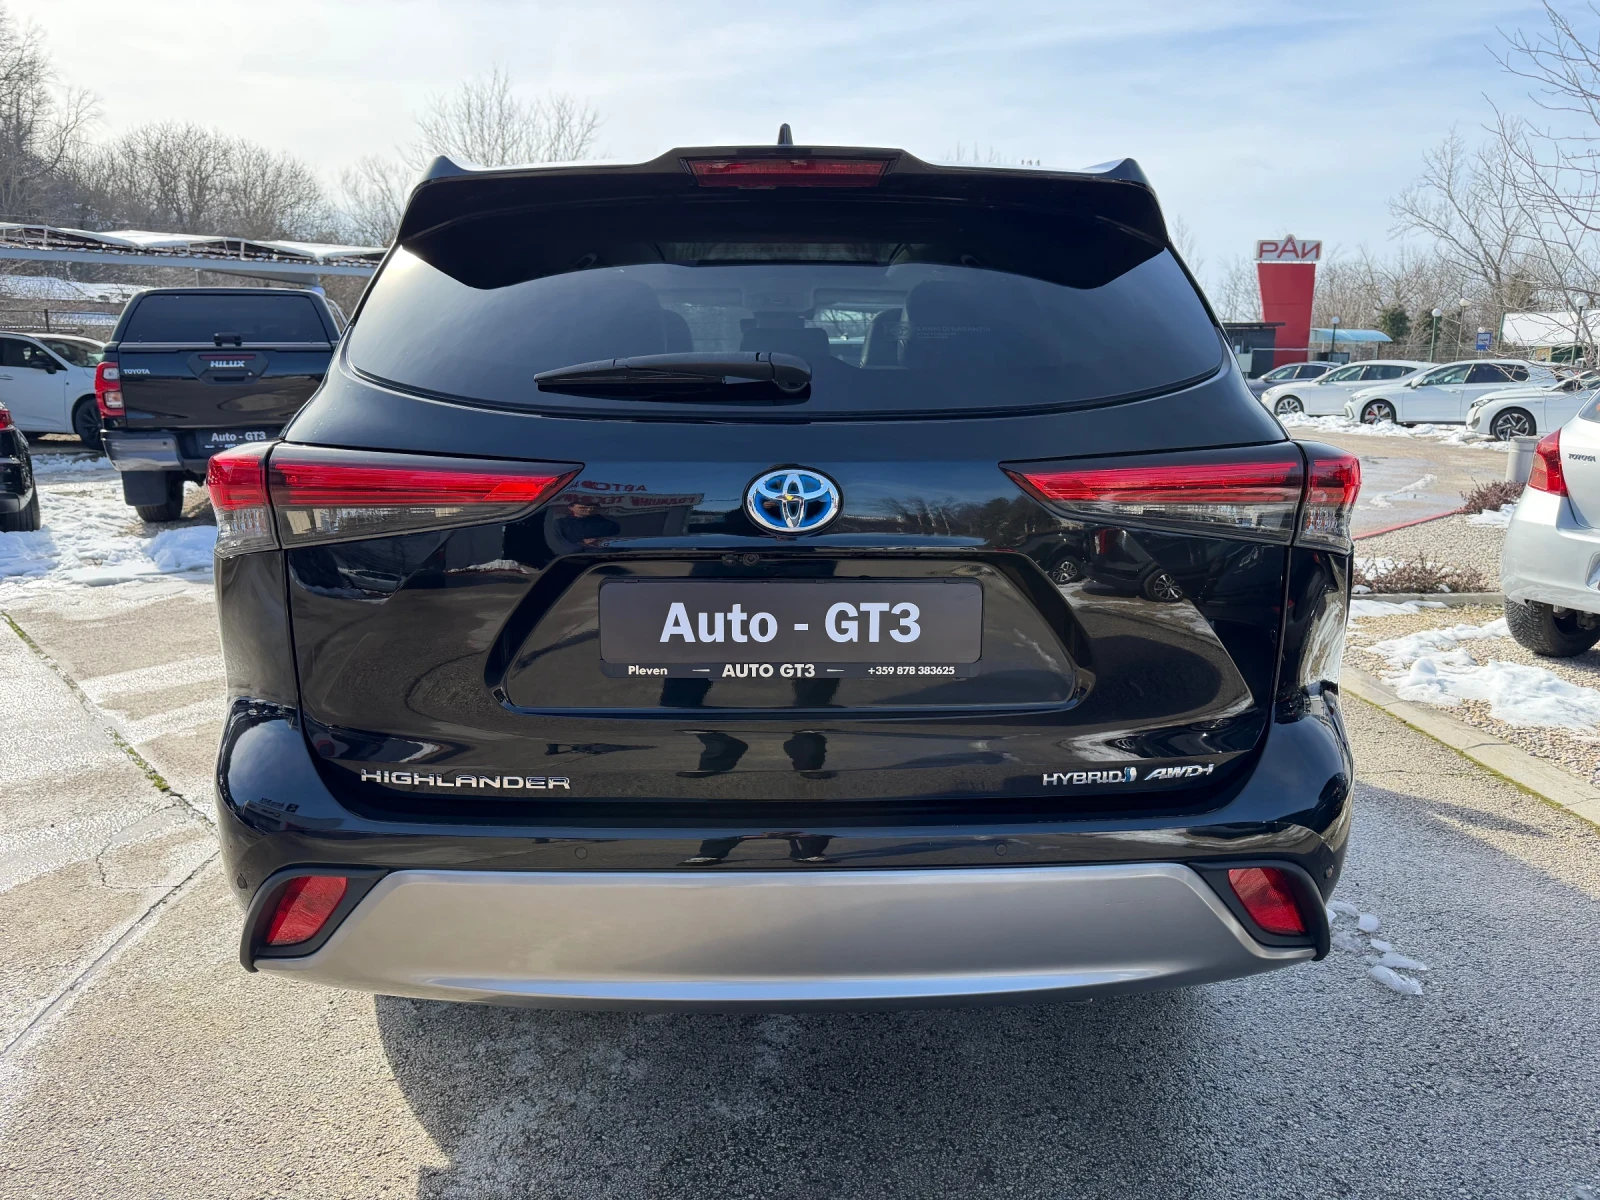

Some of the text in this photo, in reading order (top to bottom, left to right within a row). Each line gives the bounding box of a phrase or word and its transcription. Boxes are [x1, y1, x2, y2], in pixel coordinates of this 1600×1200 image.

[210, 360, 245, 368] HILUX
[211, 433, 237, 442] Auto
[244, 431, 267, 441] GT3
[1568, 452, 1596, 463] TOYOTA
[659, 602, 778, 643] Auto
[824, 601, 921, 643] GT3
[628, 665, 668, 676] Pleven
[721, 664, 816, 678] AUTO GT3
[867, 665, 955, 676] +359 878 383625
[360, 768, 571, 790] HIGHLANDER
[1042, 770, 1125, 786] HYBRID
